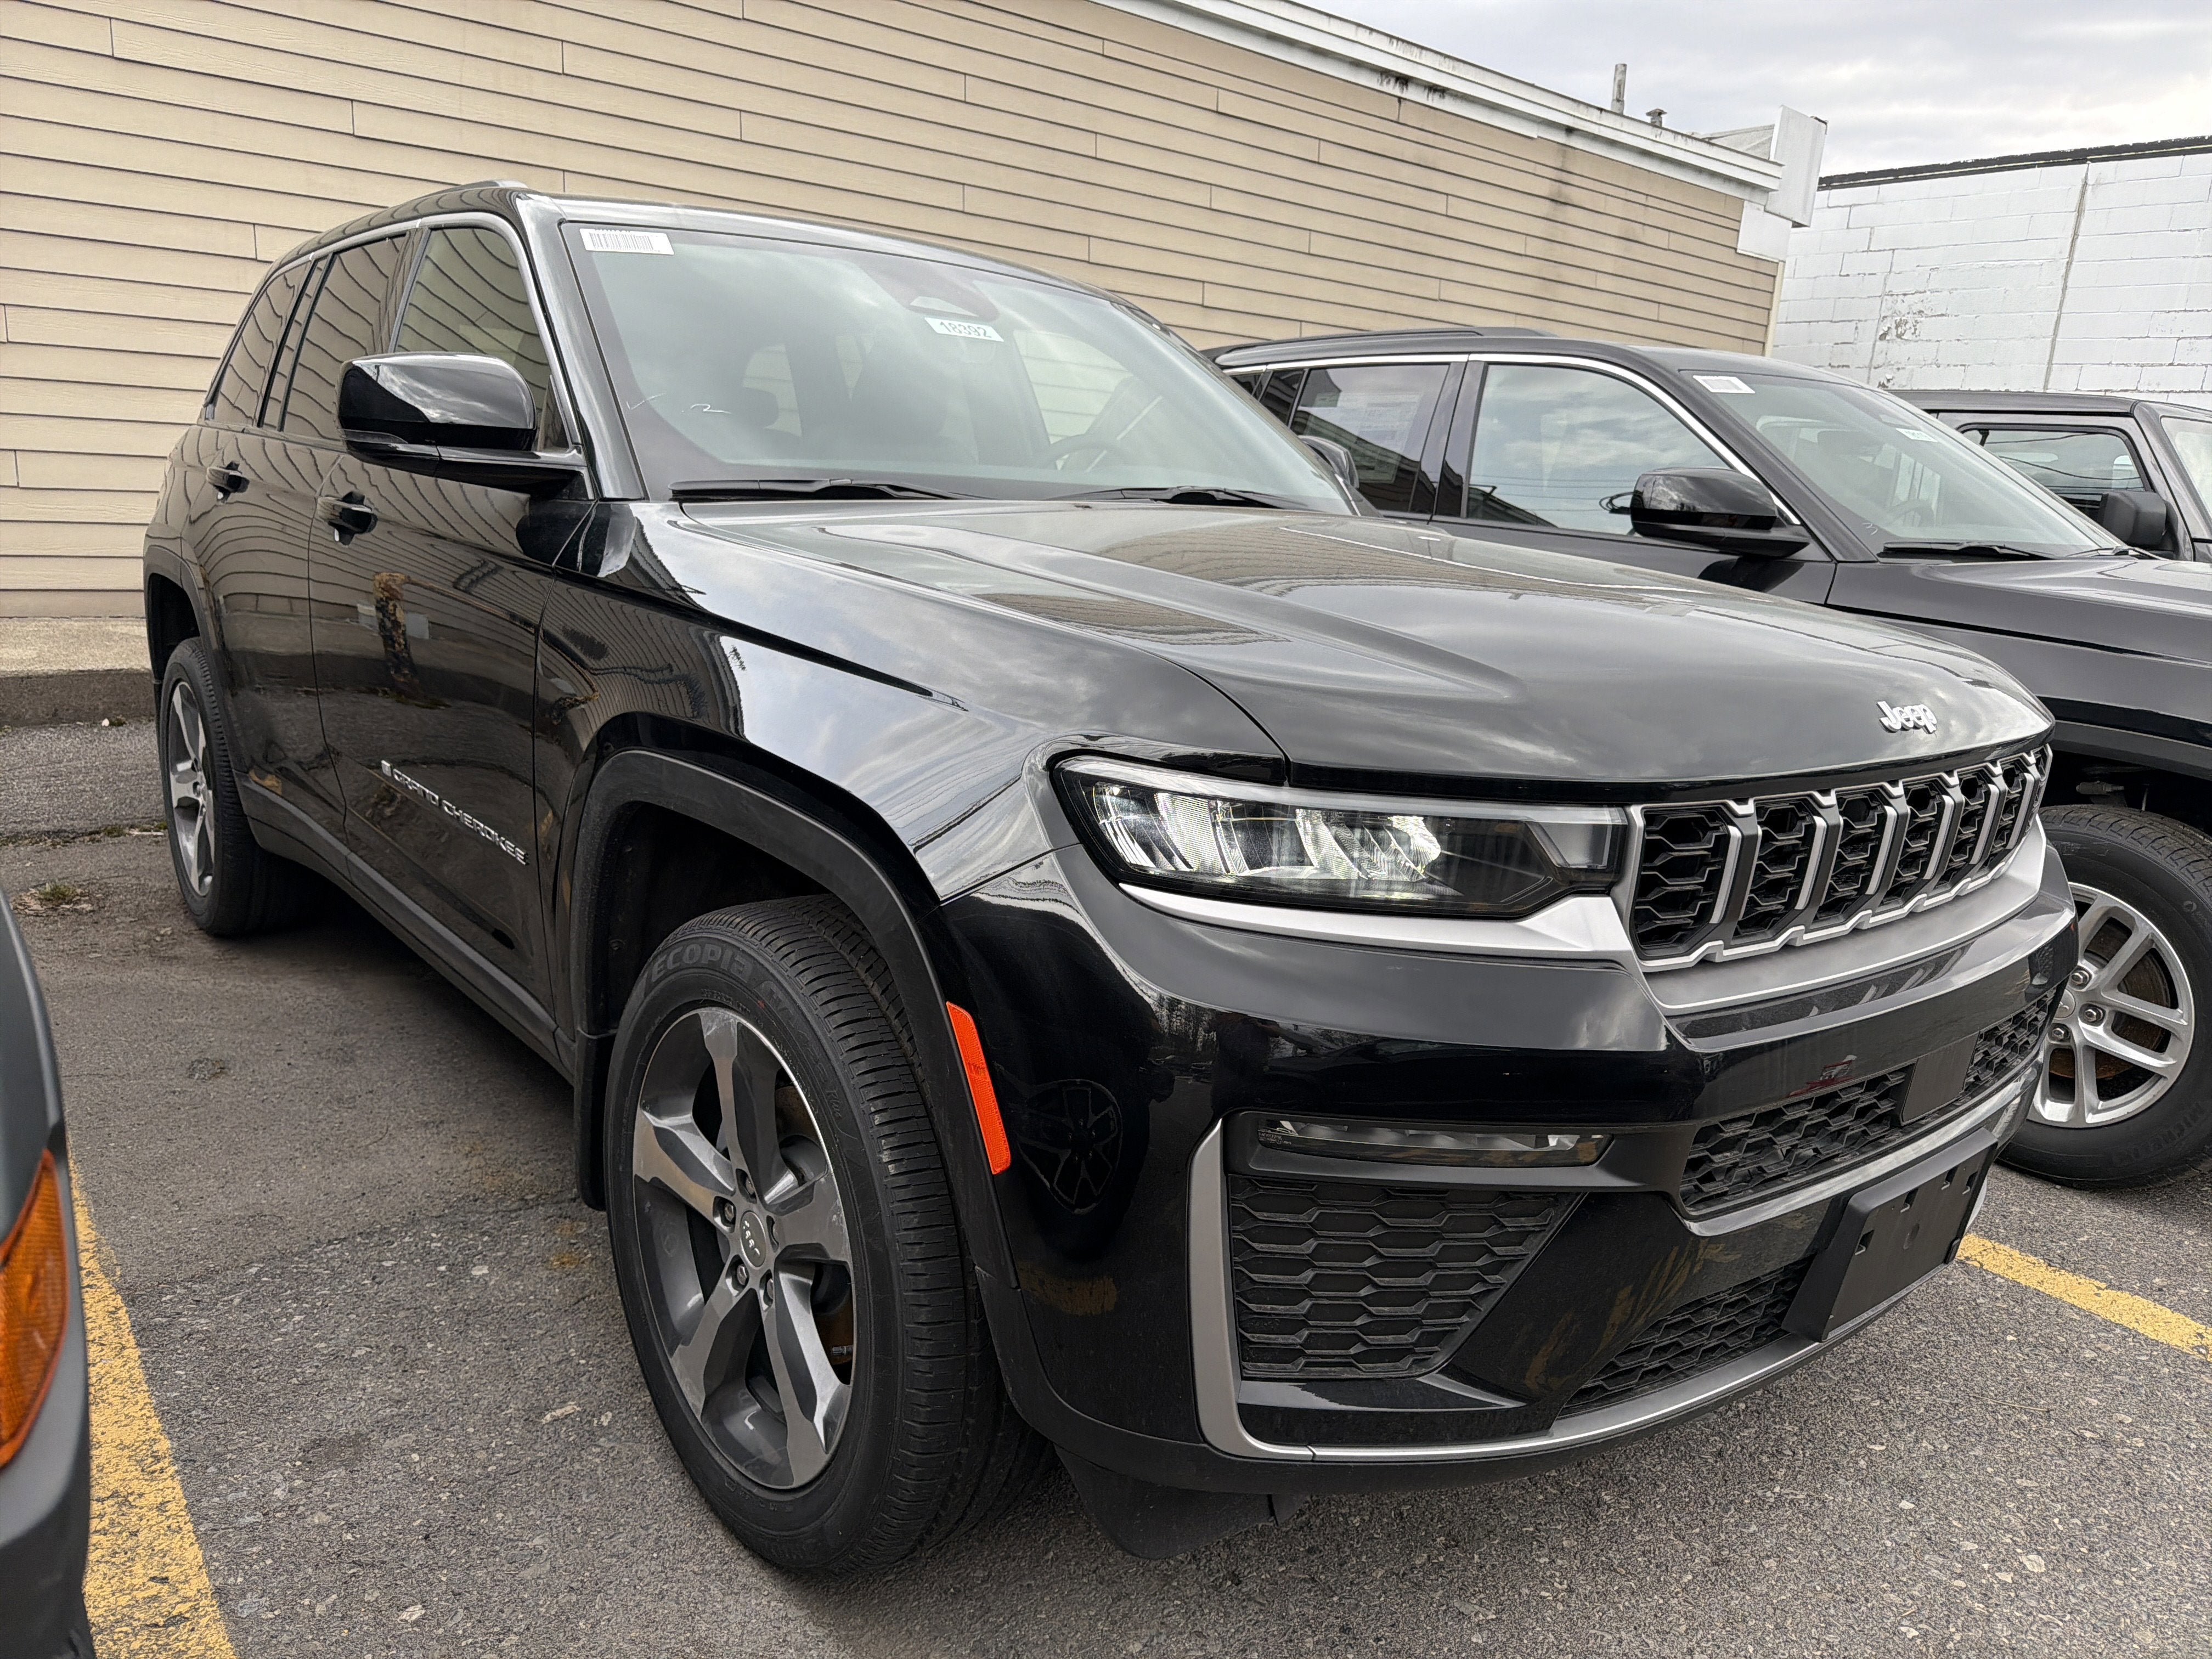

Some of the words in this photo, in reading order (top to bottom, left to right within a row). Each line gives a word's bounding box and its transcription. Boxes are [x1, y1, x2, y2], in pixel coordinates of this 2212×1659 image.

[940, 321, 992, 338] 18392
[1876, 701, 1937, 734] Jeep
[393, 769, 439, 806] GRAND
[442, 800, 528, 866] CHEROKEE
